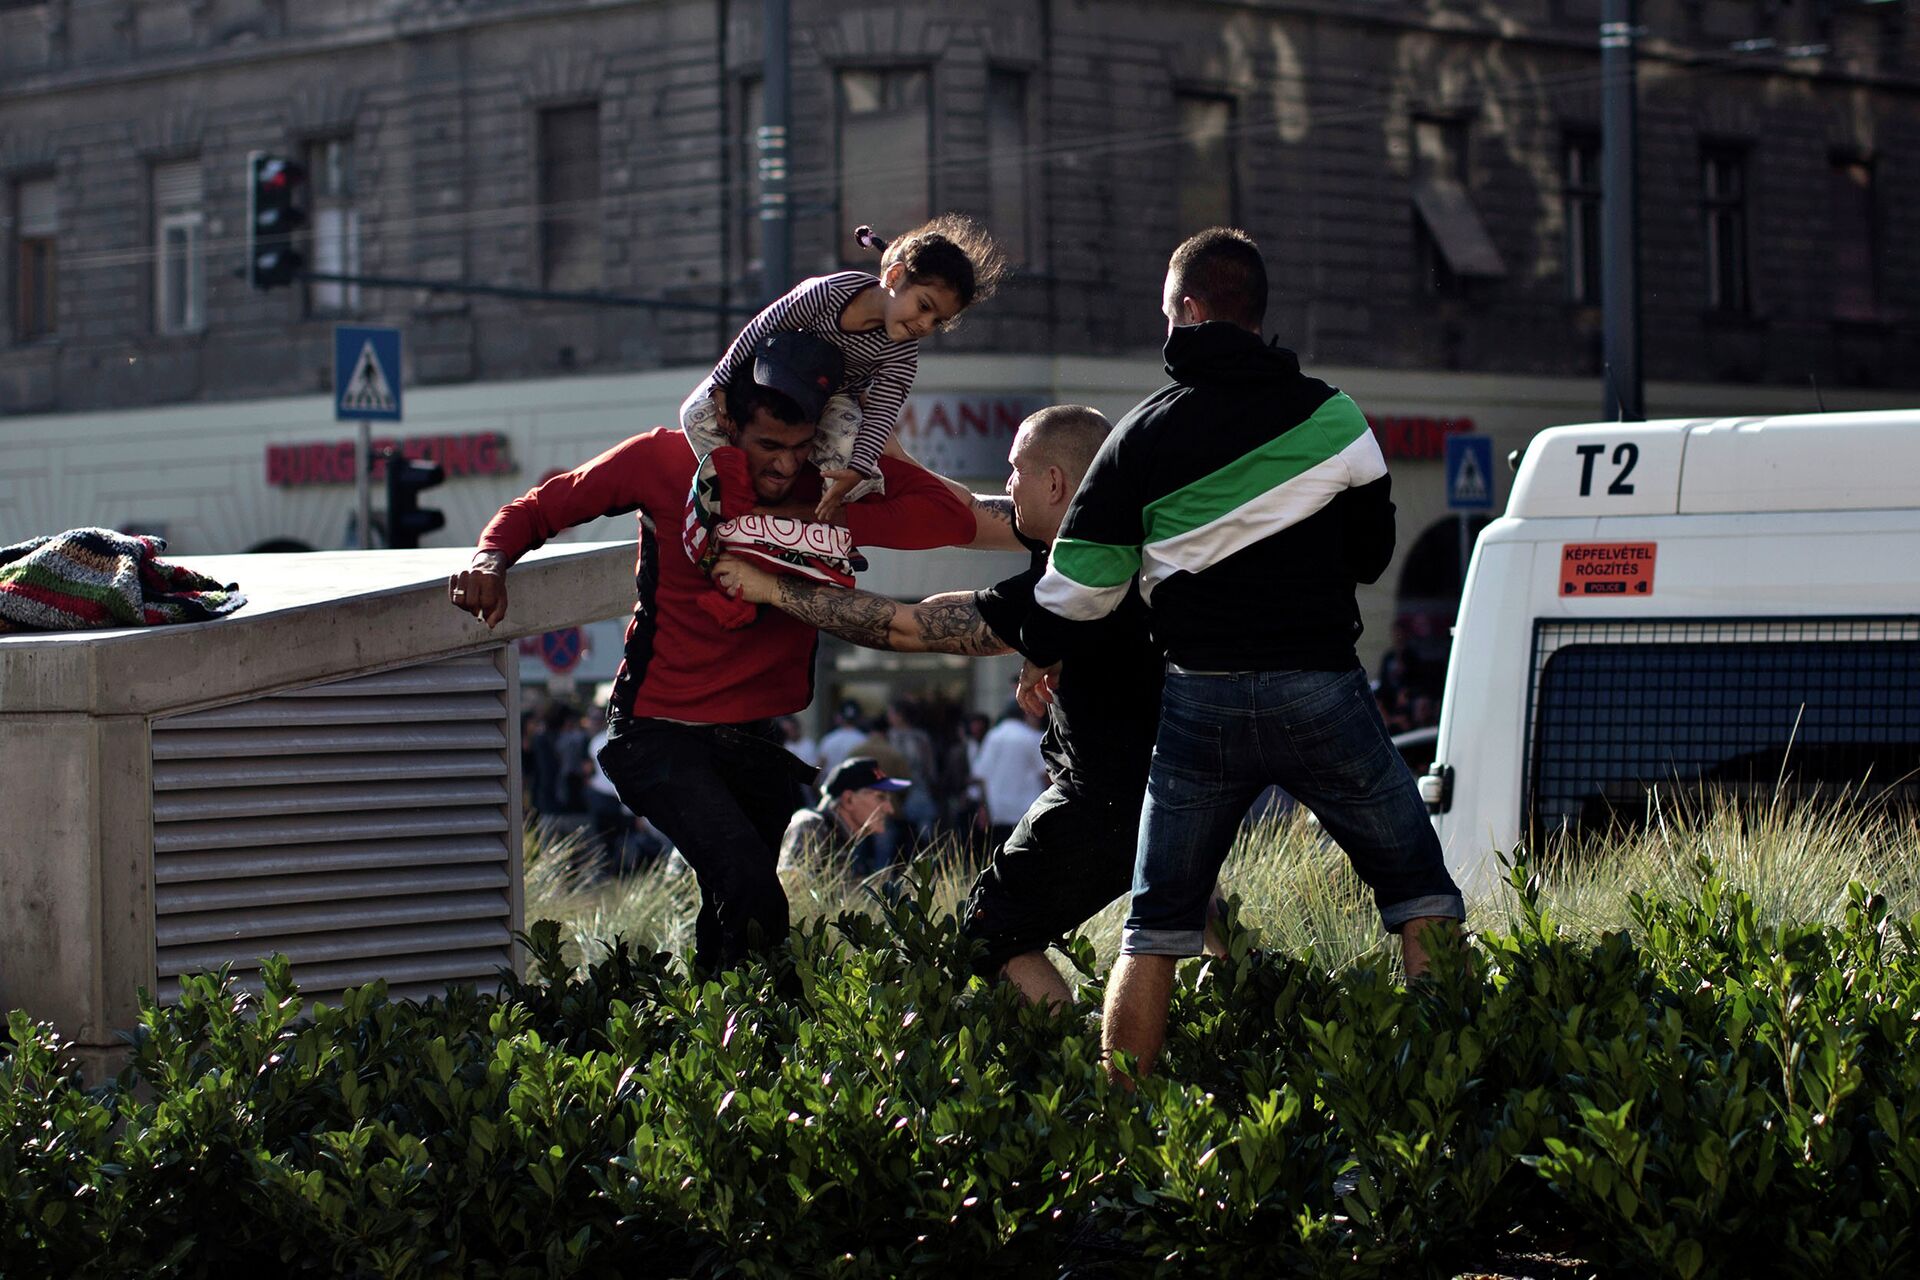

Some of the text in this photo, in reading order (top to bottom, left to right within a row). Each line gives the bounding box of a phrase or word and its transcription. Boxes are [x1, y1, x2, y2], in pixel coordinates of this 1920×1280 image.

[1576, 442, 1639, 497] T2
[1565, 546, 1652, 560] KÉPFELVÉTEL
[1590, 583, 1621, 593] POLICE
